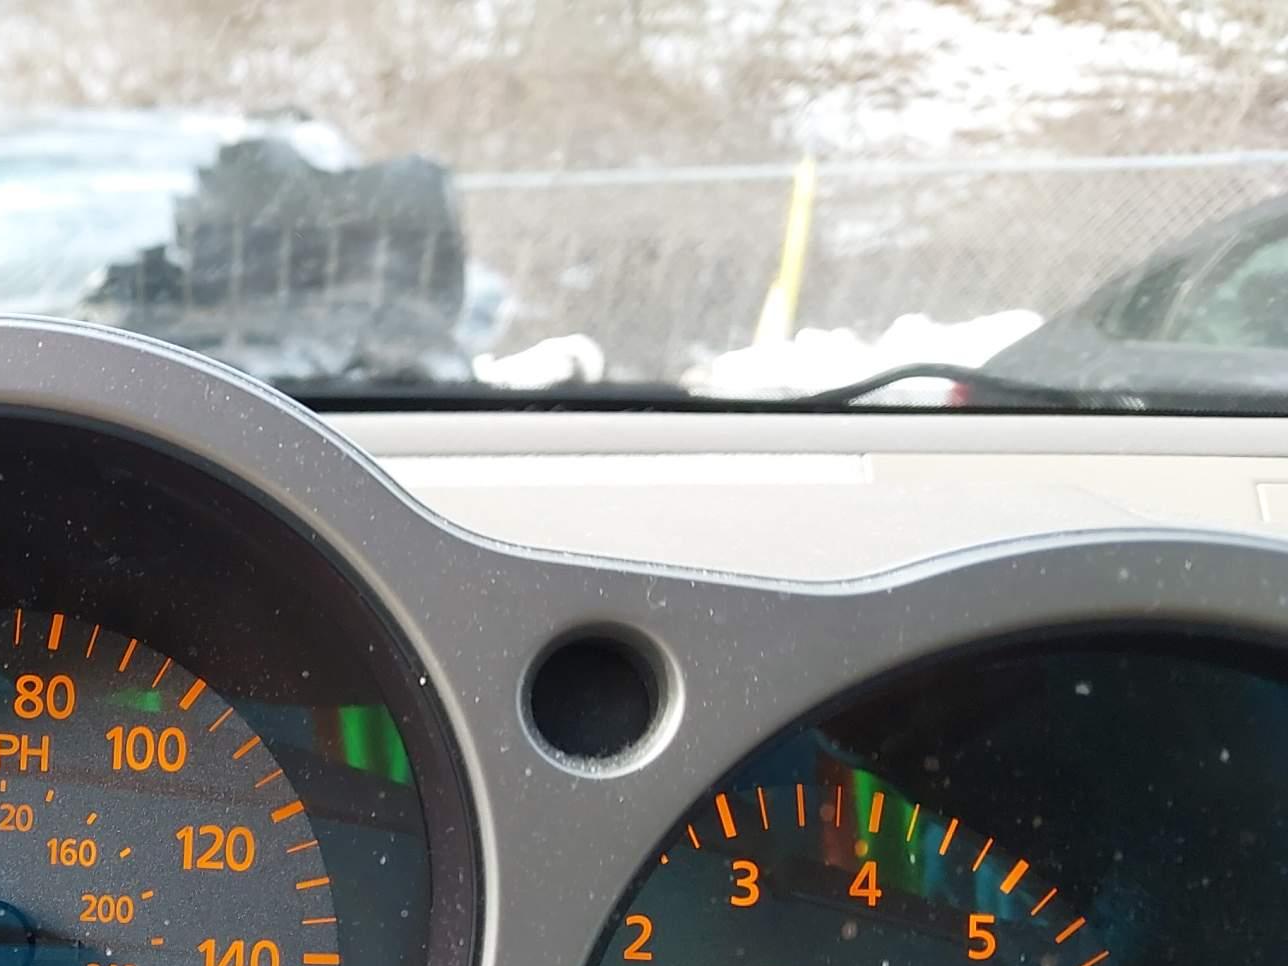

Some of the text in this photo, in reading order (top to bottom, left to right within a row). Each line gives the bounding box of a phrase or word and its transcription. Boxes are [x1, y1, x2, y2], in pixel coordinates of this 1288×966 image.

[14, 674, 75, 720] 80
[106, 726, 188, 774] 100
[47, 837, 97, 868] 160
[176, 825, 255, 872] 120
[730, 859, 760, 907] 3
[849, 861, 882, 907] 4
[80, 894, 134, 924] 200
[623, 914, 653, 961] 2
[968, 912, 997, 960] 5
